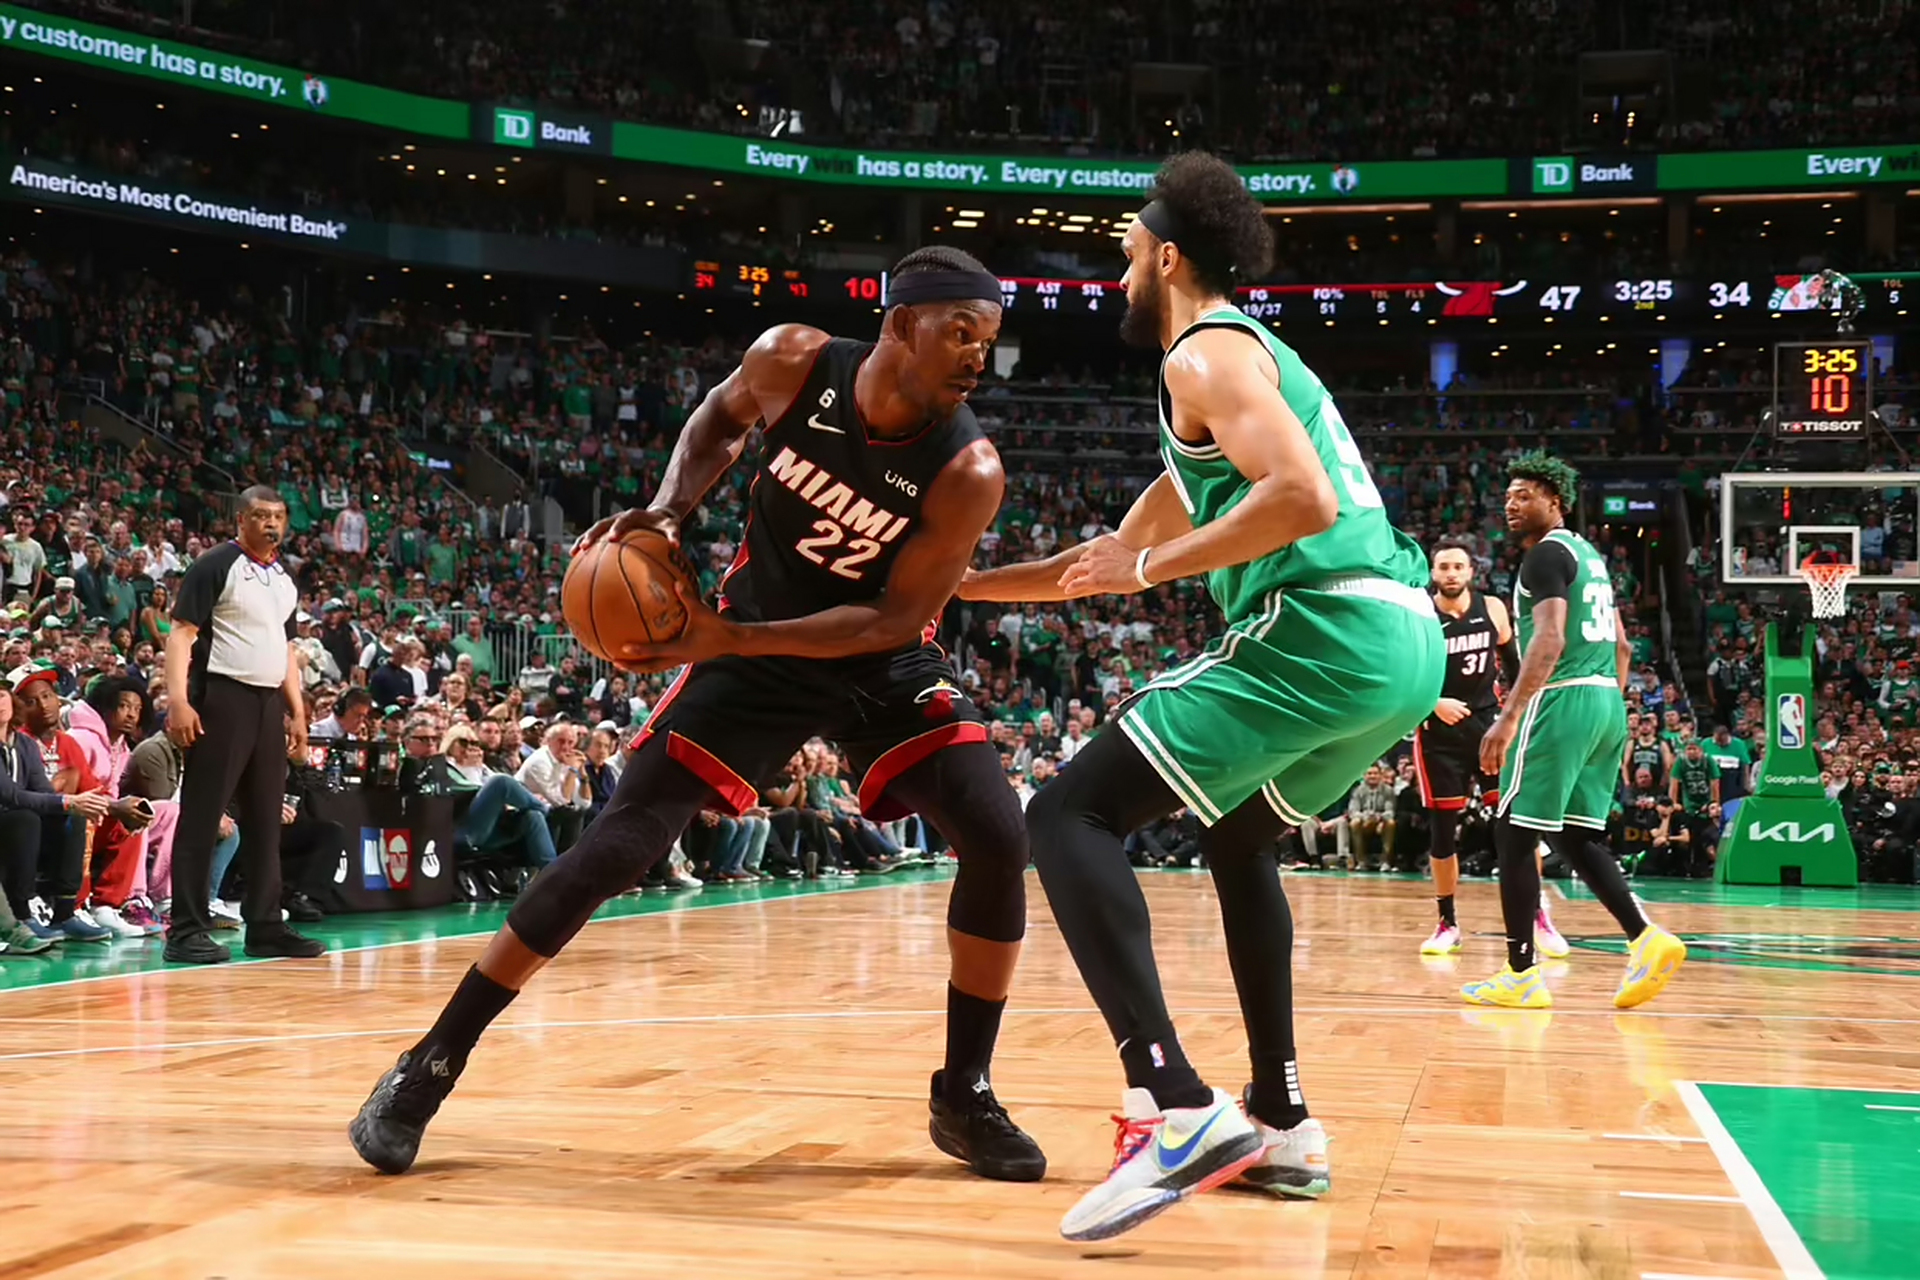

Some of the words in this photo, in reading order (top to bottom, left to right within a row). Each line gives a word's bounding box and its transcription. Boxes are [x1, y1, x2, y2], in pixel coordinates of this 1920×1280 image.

[20, 21, 147, 64] customer
[151, 44, 197, 76] has
[200, 61, 216, 79] a
[219, 65, 287, 97] story.
[497, 113, 530, 139] TD
[541, 121, 591, 145] Bank
[746, 144, 809, 174] Every
[813, 152, 852, 174] win
[857, 155, 900, 177] has
[904, 162, 920, 178] a
[923, 160, 989, 184] story.
[1536, 163, 1570, 186] TD
[1581, 163, 1633, 182] Bank
[1807, 155, 1882, 177] Every
[1888, 151, 1920, 171] wi
[1001, 162, 1067, 188] Every
[1070, 169, 1158, 188] custom
[1249, 173, 1316, 194] story.
[10, 165, 118, 201] America's
[120, 185, 172, 211] Most
[174, 194, 288, 232] Convenient
[843, 277, 879, 300] 10
[1036, 281, 1062, 295] AST
[1082, 283, 1105, 297] STL
[1250, 289, 1268, 301] FG
[1313, 288, 1345, 300] FG%
[1539, 286, 1581, 310] 47
[1614, 280, 1673, 301] 3:25
[1708, 282, 1751, 307] 34
[1889, 291, 1899, 304] 5
[1042, 296, 1058, 310] 11
[1087, 298, 1098, 311] 4
[1242, 303, 1282, 318] 19/37
[1319, 302, 1336, 314] 51
[1376, 301, 1387, 313] 5
[1410, 300, 1421, 312] 4
[1804, 349, 1857, 372] 3:25
[819, 388, 836, 409] 6
[1810, 374, 1850, 413] 10
[1801, 420, 1863, 432] TISSOT
[768, 446, 910, 543] MIAMI
[795, 519, 881, 580] 22
[1581, 582, 1617, 642] 36
[1446, 631, 1490, 654] IAMI
[1461, 651, 1488, 675] 31
[1764, 775, 1797, 786] Google
[1749, 820, 1835, 843] KIA
